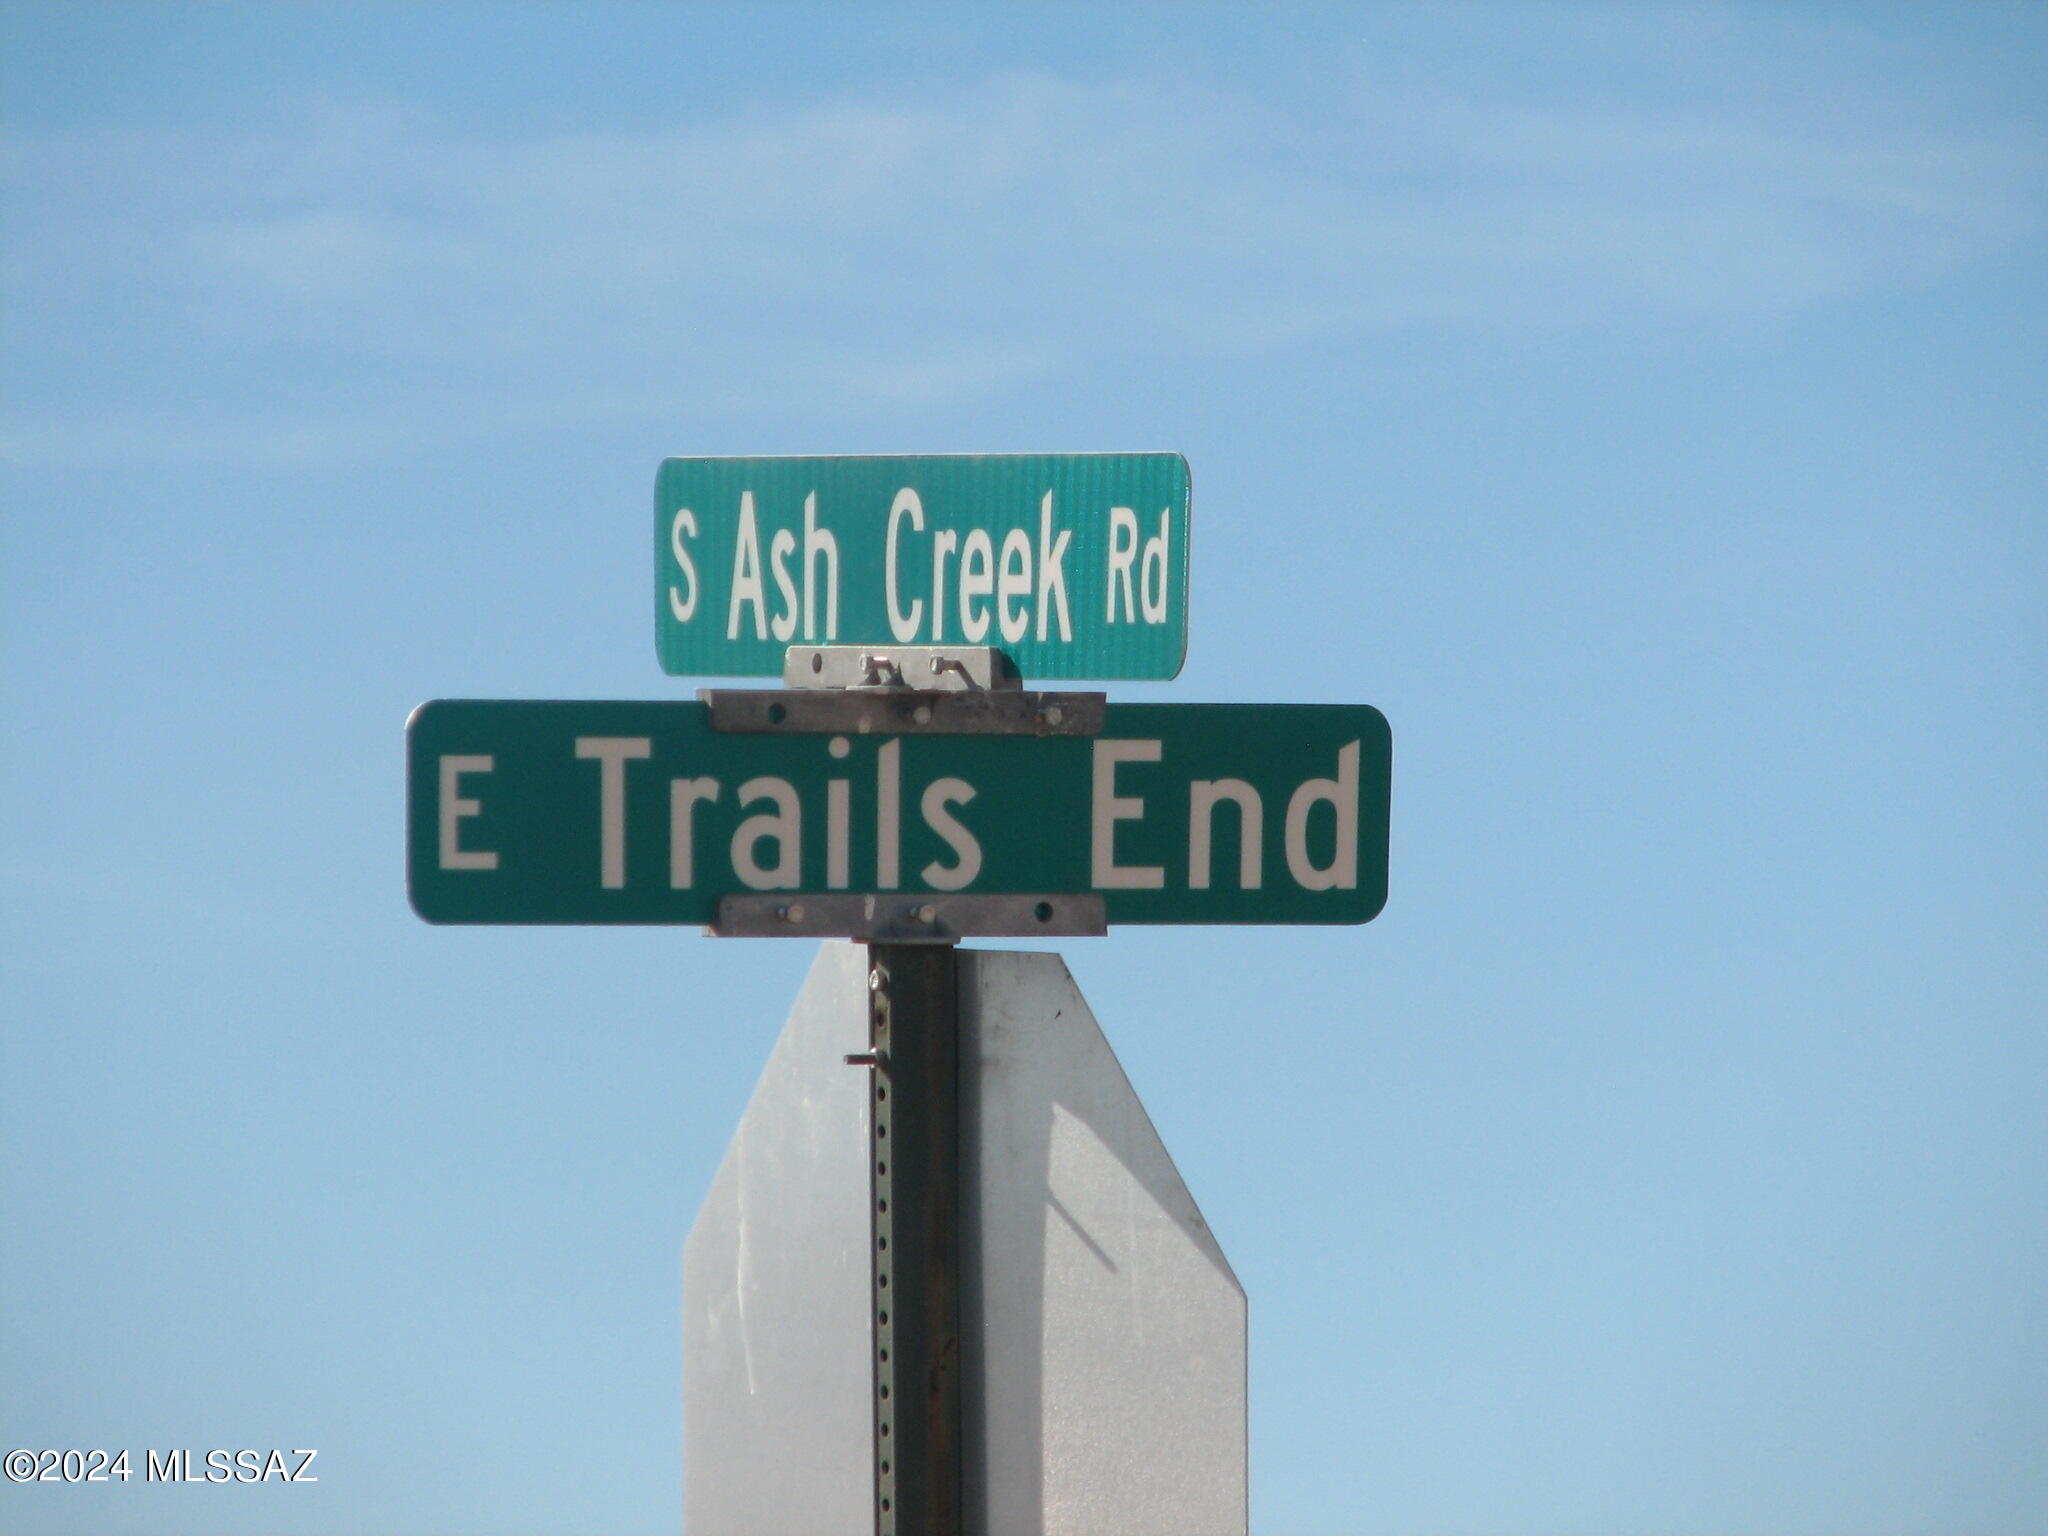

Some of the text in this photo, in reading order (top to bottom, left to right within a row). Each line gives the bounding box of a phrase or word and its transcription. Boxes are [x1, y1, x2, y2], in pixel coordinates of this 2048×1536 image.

[669, 487, 1170, 644] S Ash Creek Rd
[439, 736, 1361, 891] E Trails End
